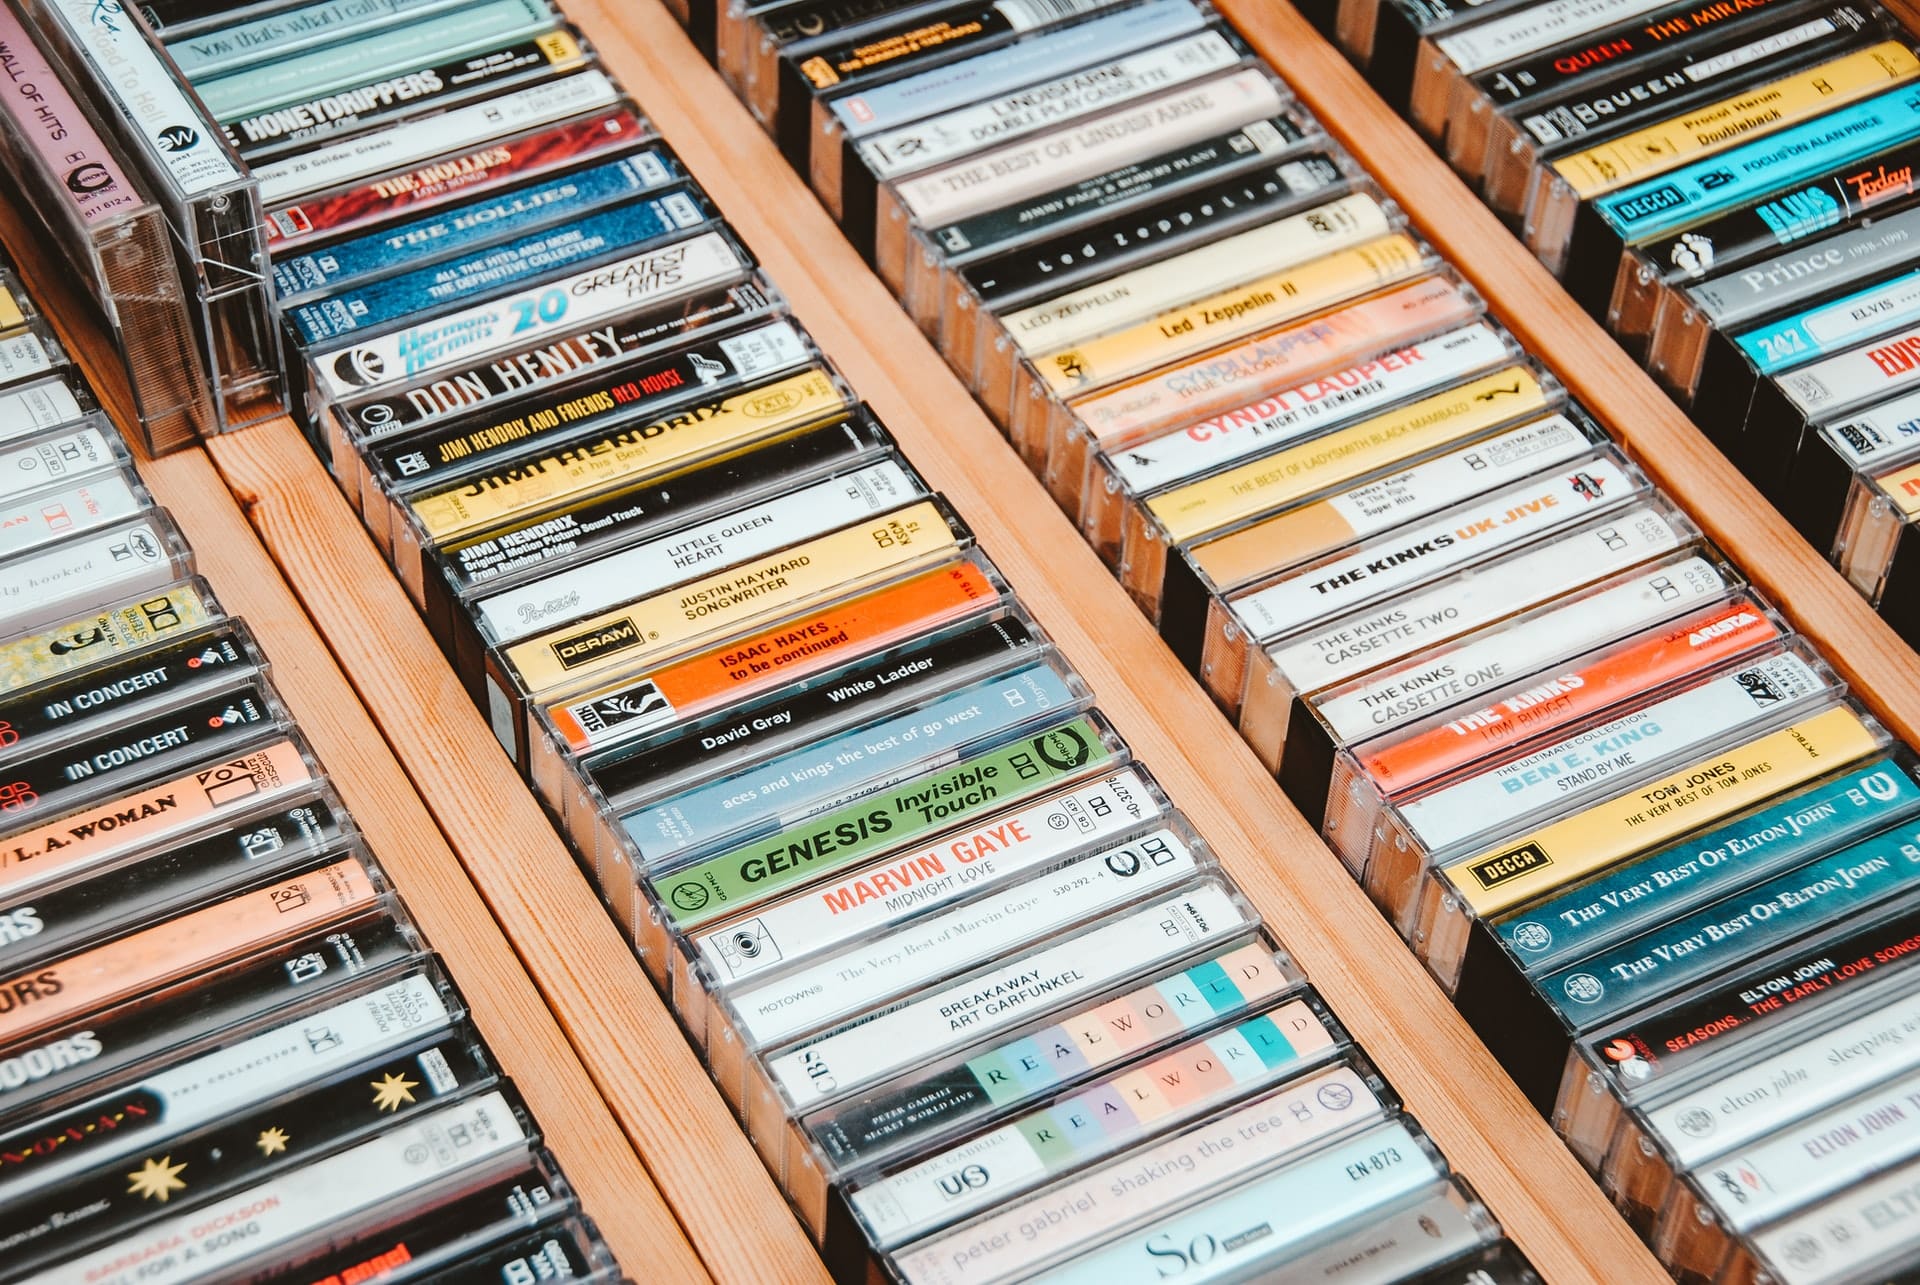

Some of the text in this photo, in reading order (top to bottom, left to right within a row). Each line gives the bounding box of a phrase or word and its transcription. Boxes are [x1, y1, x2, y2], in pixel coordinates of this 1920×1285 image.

[190, 24, 285, 59] Now that's
[1553, 38, 1634, 75] QUEEN
[1644, 17, 1693, 41] THE
[20, 82, 68, 142] OF HITS
[241, 69, 444, 143] HONEYDRIPPERS
[970, 66, 1171, 142] DOUBLE PLAY CASSETTE
[992, 65, 1128, 118] LINDISFARNE
[1592, 71, 1686, 115] QUEEN
[1682, 90, 1783, 131] Procol Harum
[941, 164, 991, 193] THE
[990, 147, 1045, 180] BEST
[1044, 139, 1077, 161] OF
[1076, 92, 1215, 149] LINDISFARNE
[1696, 108, 1784, 147] Doubleback
[1742, 115, 1884, 174] FOCUS ON ALAN PRICE
[292, 161, 308, 173] 20
[310, 152, 351, 168] Golden
[418, 146, 512, 186] HOLLIES
[1846, 165, 1914, 208] Today
[85, 196, 132, 218] 511 612-4
[386, 183, 578, 250] THE HOLLIES
[1619, 188, 1681, 221] DECCA
[485, 229, 585, 269] HITS AND MORE
[528, 235, 605, 267] COLLECTION
[1741, 248, 1845, 294] Prince
[508, 288, 569, 336] 20
[1019, 285, 1132, 333] LED ZEPPELIN
[1160, 289, 1277, 340] Led Zeppelin
[1850, 299, 1895, 321] ELVIS
[406, 366, 487, 420] DON
[438, 368, 685, 463] JIMI HENDRIX AND FRIENDS RED HOUSE
[1265, 411, 1300, 434] NIGHT
[1230, 468, 1284, 496] THE BEST
[459, 514, 579, 563] JIMI HENDRIX
[464, 506, 644, 573] Original Motion Picture Sound Track
[666, 513, 775, 558] LITTLE QUEEN
[673, 544, 726, 570] HEART
[1310, 493, 1560, 596] THE KINKS UK JIVE
[28, 560, 94, 589] hooked
[470, 540, 577, 583] From Rainbow Bridge
[679, 555, 811, 610] JUSTIN HAYWARD
[685, 576, 790, 621] SONGWRITER
[560, 626, 636, 660] DERAM
[718, 621, 829, 669] ISAAC HAYES
[1312, 608, 1409, 652] THE KINKS
[1324, 605, 1461, 666] CASSETTE TWO
[1688, 612, 1760, 648] ARISTA
[730, 630, 850, 681] to be continued
[45, 666, 169, 720] IN CONCERT
[701, 655, 934, 752] David Gray White Ladder
[1359, 664, 1456, 708] THE KINKS
[1371, 661, 1505, 725] CASSETTE ONE
[1574, 711, 1649, 746] COLLECTION
[63, 726, 191, 781] IN CONCERT
[721, 789, 759, 811] aces
[761, 774, 795, 800] and
[795, 757, 836, 793] kings
[836, 747, 863, 769] the
[864, 734, 900, 760] best
[901, 723, 919, 746] of
[922, 718, 944, 741] go
[945, 704, 983, 731] west
[1501, 720, 1663, 794] BEN KING
[1556, 751, 1636, 793] STAND ME
[896, 762, 1000, 814] Invisible
[917, 783, 999, 825] Touch
[1624, 761, 1773, 829] THE VERY BEST TOM JONES
[1641, 761, 1737, 805] TOM JONES
[69, 793, 178, 841] WOMAN
[1786, 801, 1838, 839] JOHN
[739, 808, 894, 884] GENESIS
[822, 818, 1032, 917] MARVIN GAYE
[1483, 850, 1539, 880] DECCA
[884, 860, 997, 914] MIDNIGHT LOVE
[1838, 853, 1891, 890] JOHN
[835, 894, 1040, 984] The Best Marvin Gaye
[939, 969, 1042, 1019] BREAKAWAY
[948, 967, 1085, 1033] ART GARFUNKEL
[1738, 957, 1837, 1004] ELTON JOHN
[1749, 957, 1876, 1016] THE EARLY LOVE
[805, 1049, 838, 1094] CBS
[948, 1089, 975, 1109] LIVE
[952, 1113, 1283, 1271] peter gabriel shaking tree
[84, 1195, 282, 1284] BARBARA DICKSON
[134, 1220, 262, 1280] FOR SONG
[1145, 1230, 1218, 1281] So
